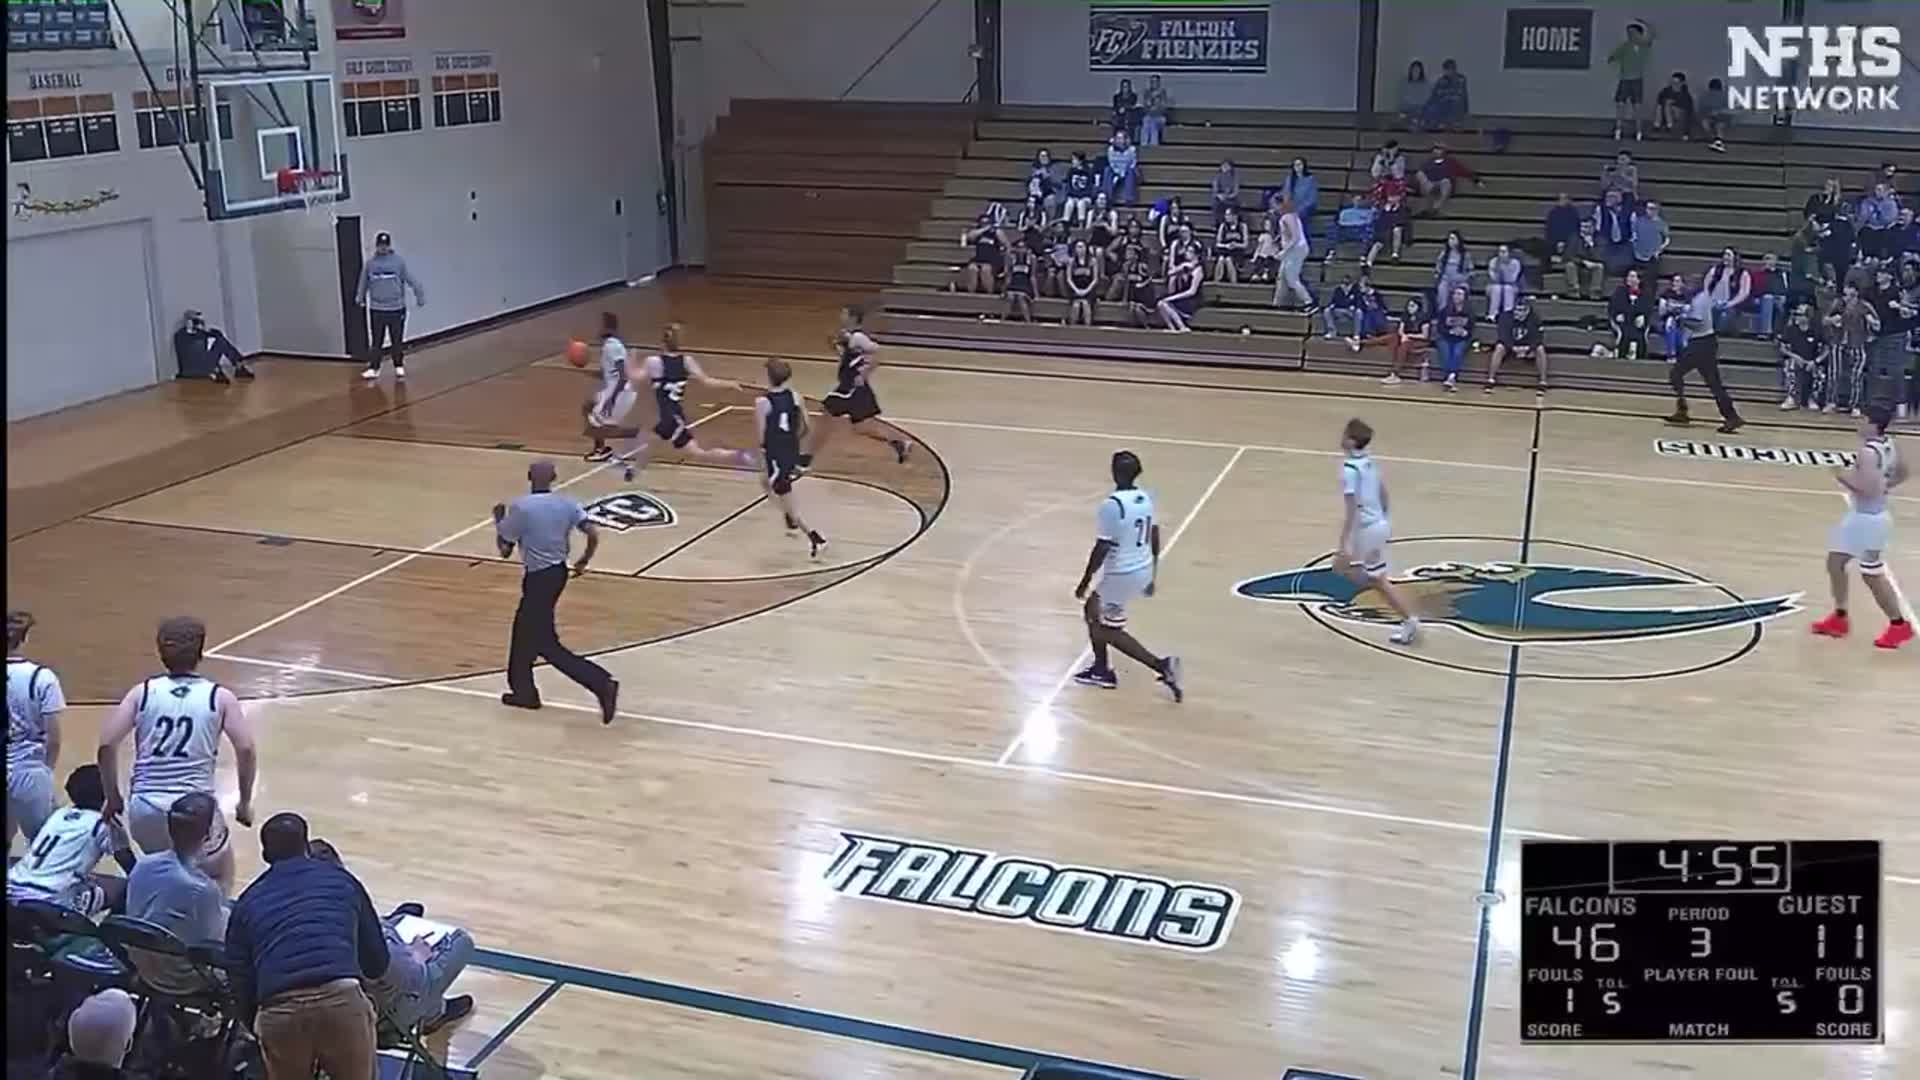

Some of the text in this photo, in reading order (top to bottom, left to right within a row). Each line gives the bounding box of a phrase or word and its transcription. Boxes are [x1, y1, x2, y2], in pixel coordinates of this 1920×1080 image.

[1160, 20, 1235, 38] FALCON
[1521, 26, 1581, 52] HOME
[1141, 39, 1259, 60] FRENZIES
[30, 73, 82, 89] BASEBALL
[153, 715, 194, 758] 22
[32, 834, 61, 870] 4
[824, 832, 1236, 948] FALCONS
